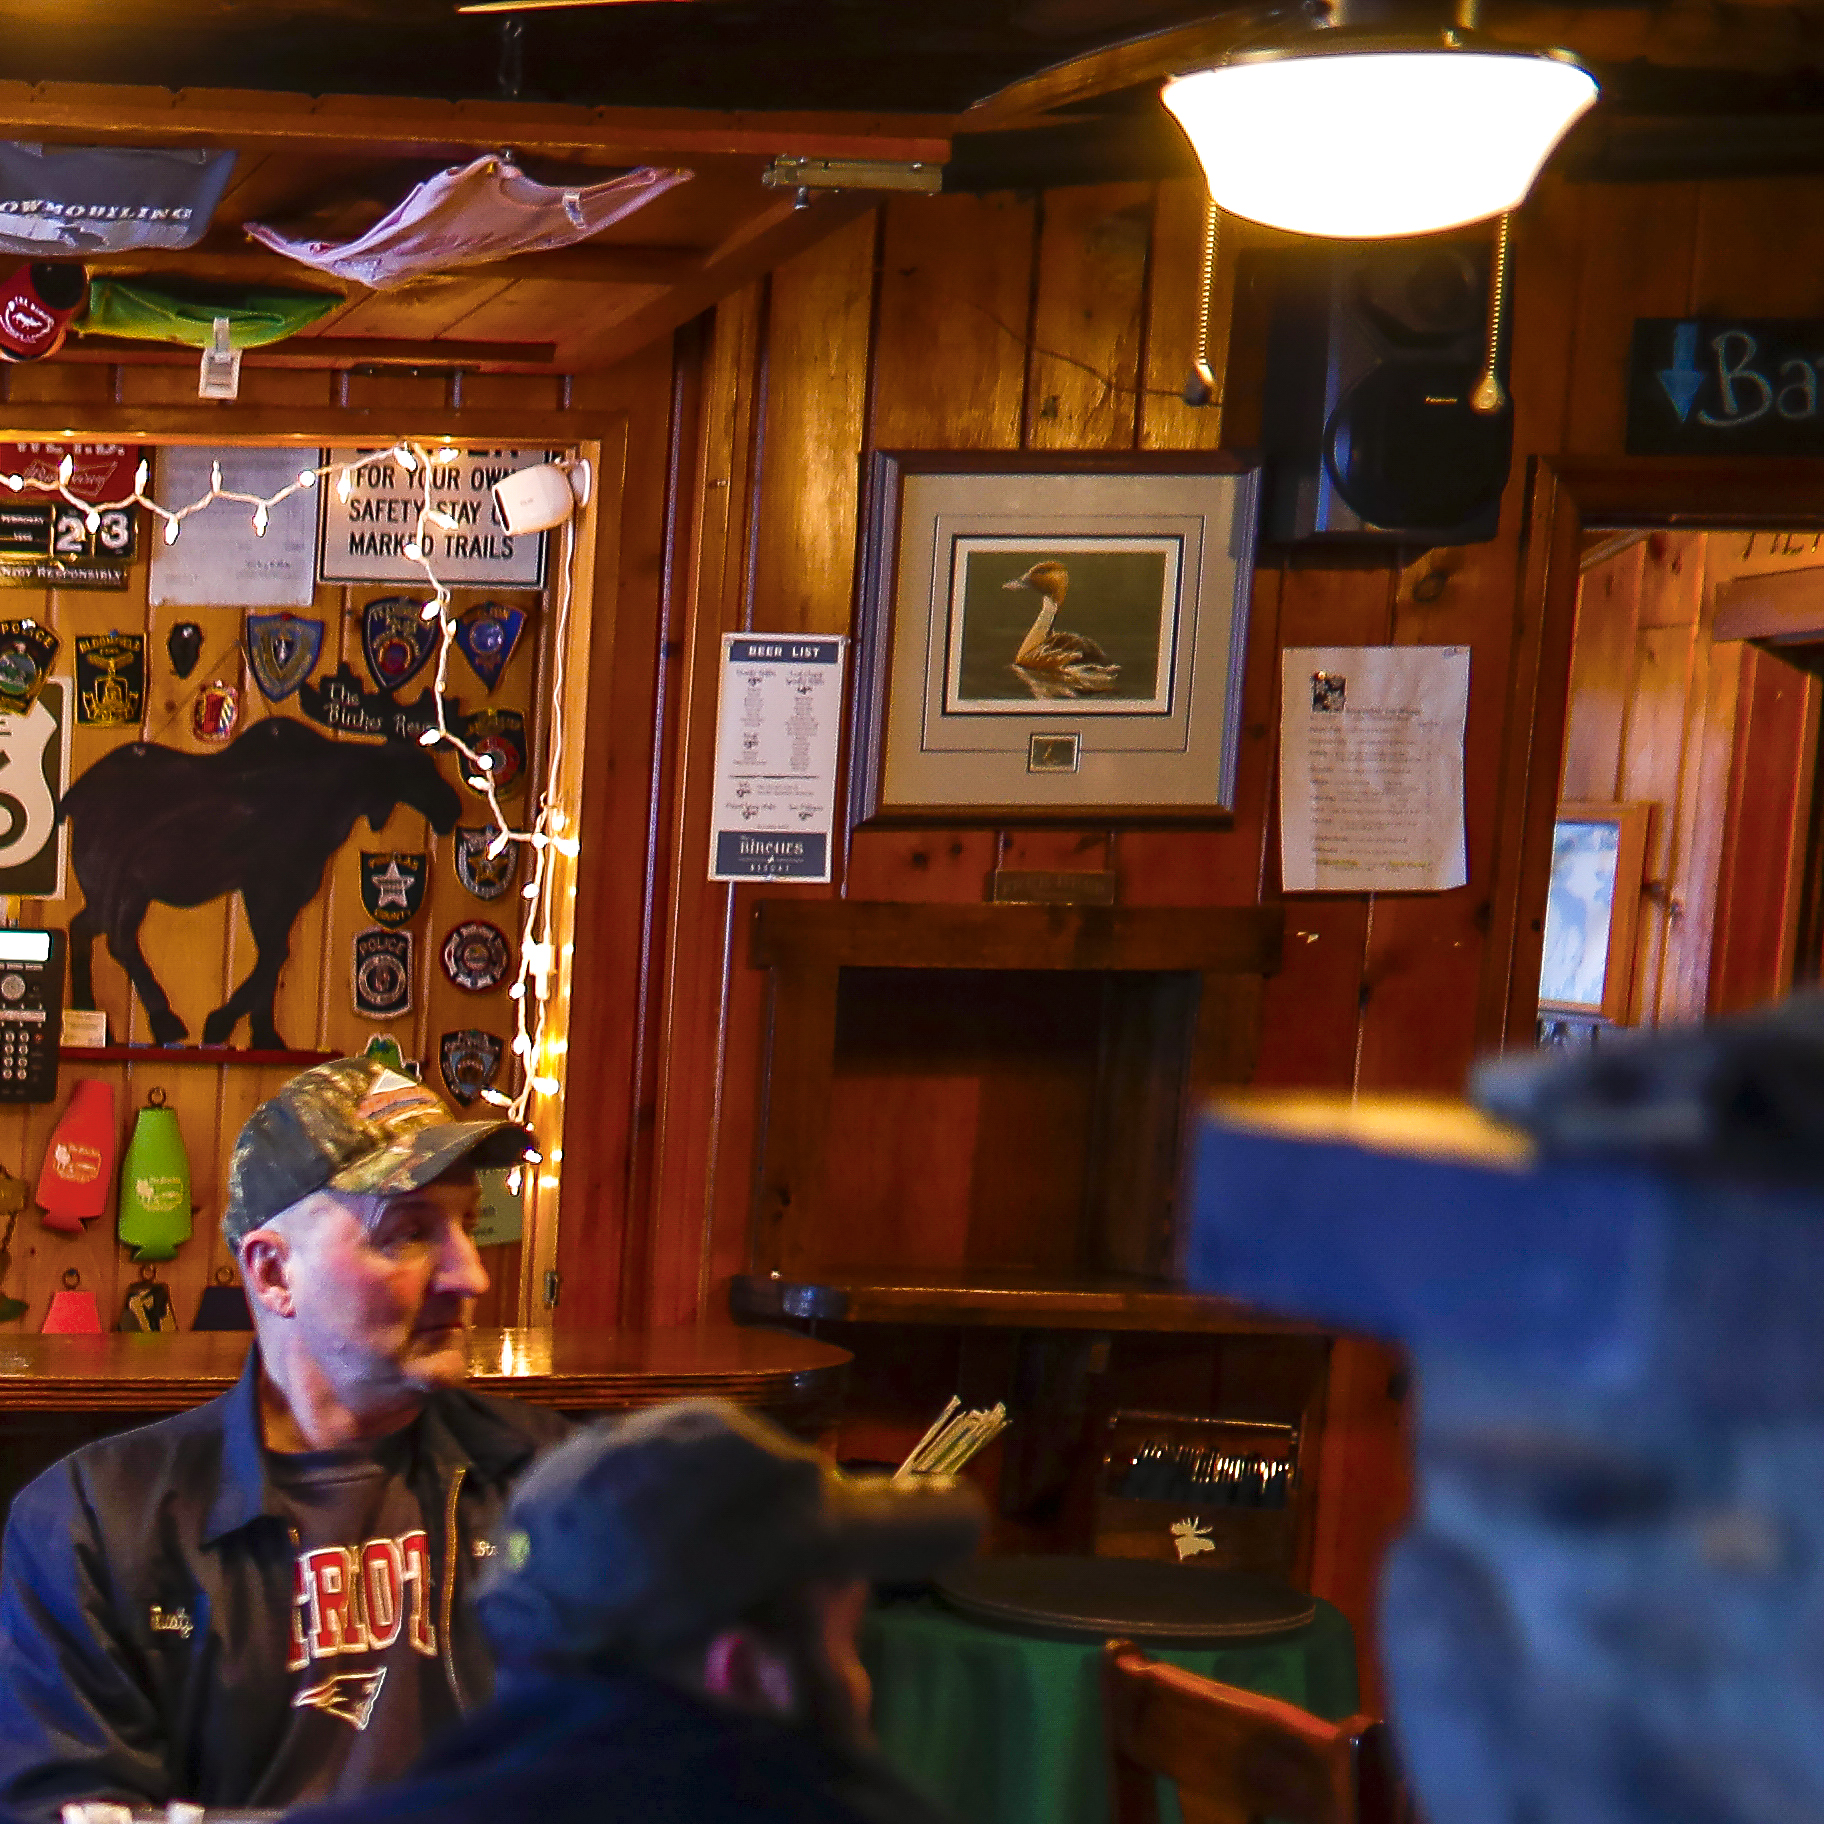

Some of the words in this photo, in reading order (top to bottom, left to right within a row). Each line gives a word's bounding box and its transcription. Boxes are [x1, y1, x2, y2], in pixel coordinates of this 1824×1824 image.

[1697, 329, 1824, 428] Ba
[355, 464, 395, 490] FOR
[348, 498, 425, 525] SAFETY
[436, 500, 482, 526] STAY
[348, 531, 435, 557] MARKD
[443, 533, 515, 560] TRAILS
